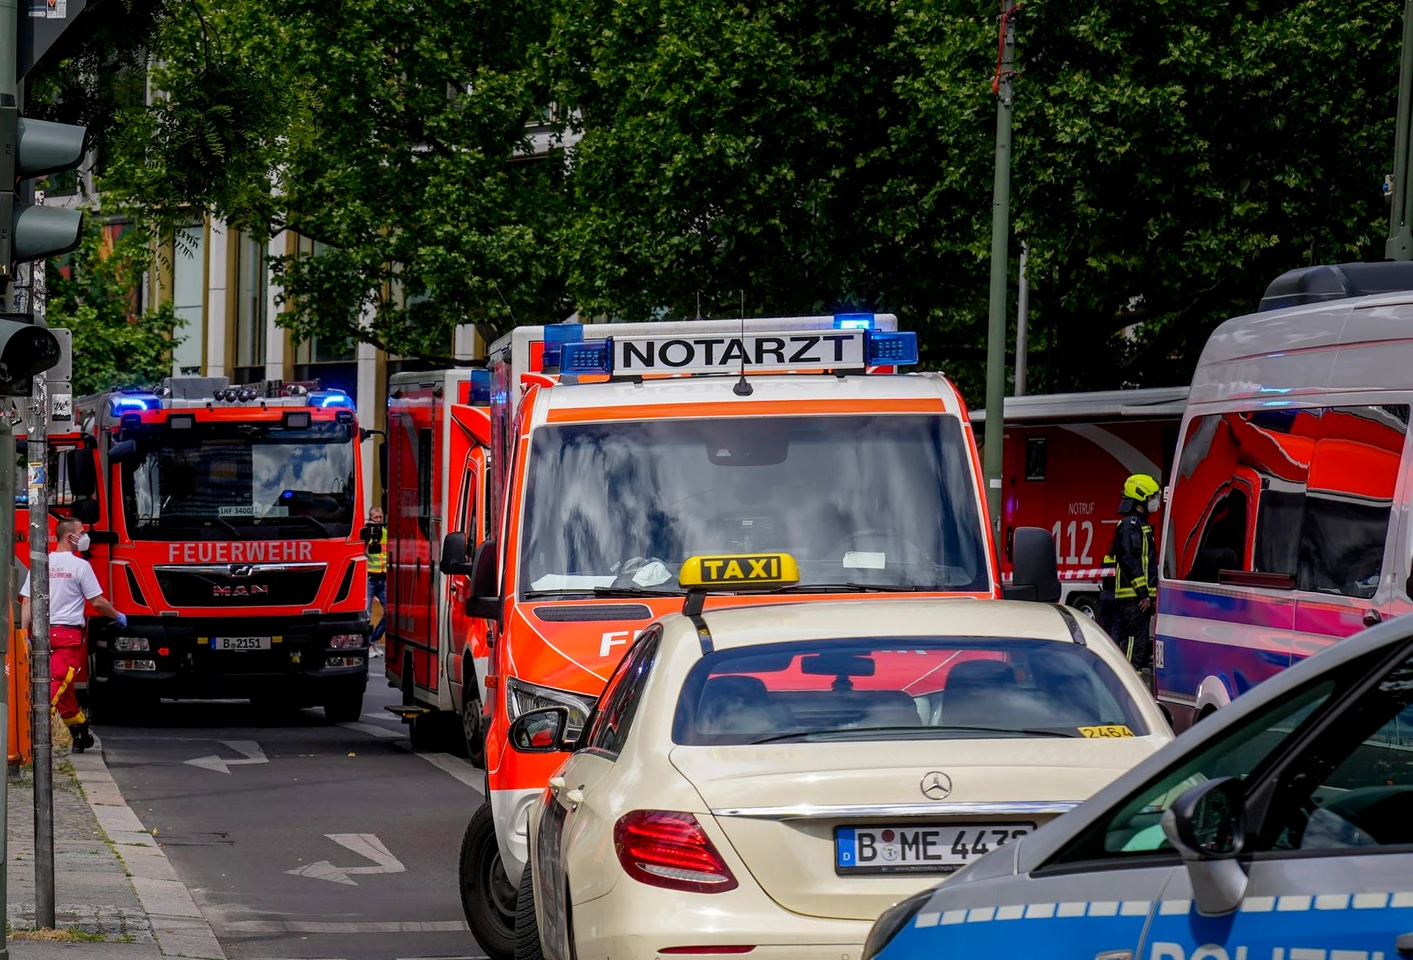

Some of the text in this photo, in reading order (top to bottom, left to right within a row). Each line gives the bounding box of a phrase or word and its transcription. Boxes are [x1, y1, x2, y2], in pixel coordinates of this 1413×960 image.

[623, 335, 854, 369] NOTARZT
[1068, 503, 1094, 515] NOTRUF
[1052, 520, 1093, 565] 112
[169, 542, 312, 562] FEUERWEHR
[704, 558, 779, 580] TAXI
[213, 585, 268, 596] MAN
[223, 638, 261, 648] B 2151
[1083, 727, 1133, 738] 2464
[858, 832, 878, 862] B
[900, 831, 942, 861] ME
[843, 853, 850, 861] D
